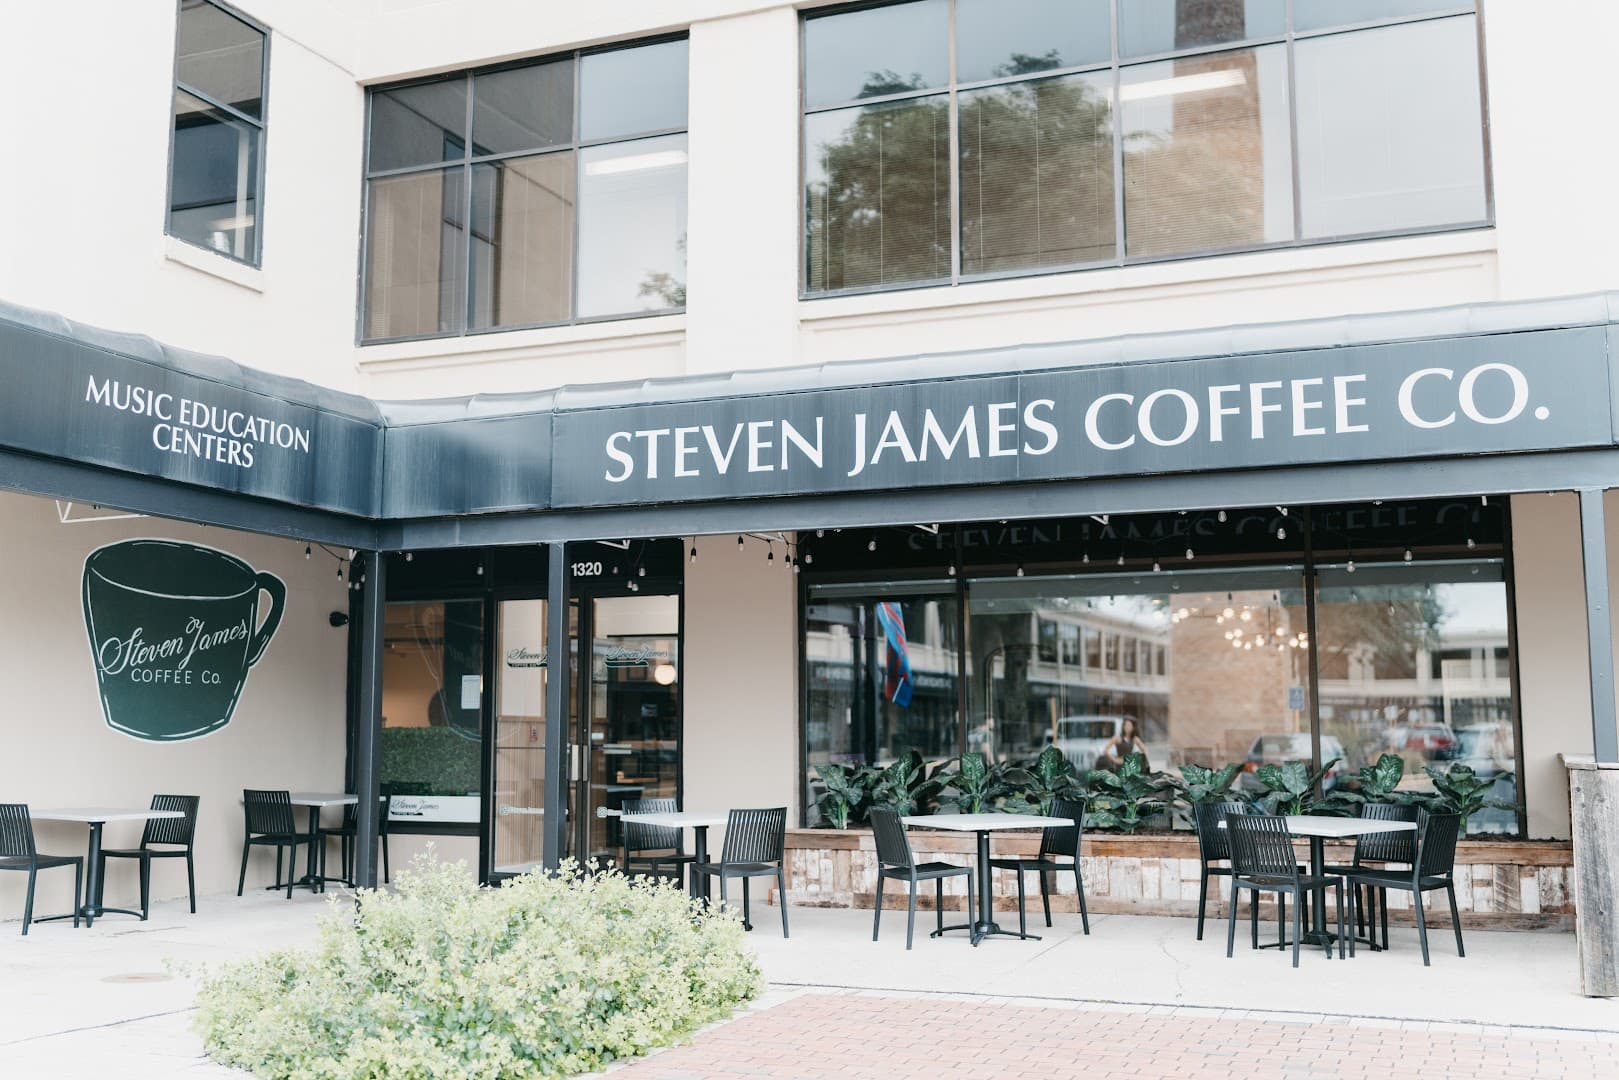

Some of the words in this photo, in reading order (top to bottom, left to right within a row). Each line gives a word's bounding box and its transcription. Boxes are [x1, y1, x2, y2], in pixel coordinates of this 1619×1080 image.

[85, 375, 173, 421] MUSIC
[178, 398, 310, 453] EDUCATION
[604, 416, 824, 482] STEVEN
[847, 399, 1060, 477] JAMES
[1084, 373, 1369, 450] COFFEE
[1398, 362, 1550, 428] CO.
[152, 423, 254, 468] CENTERS
[571, 561, 603, 577] 1320
[98, 626, 184, 675] Steven
[178, 616, 249, 670] James
[131, 668, 193, 684] COFFEE
